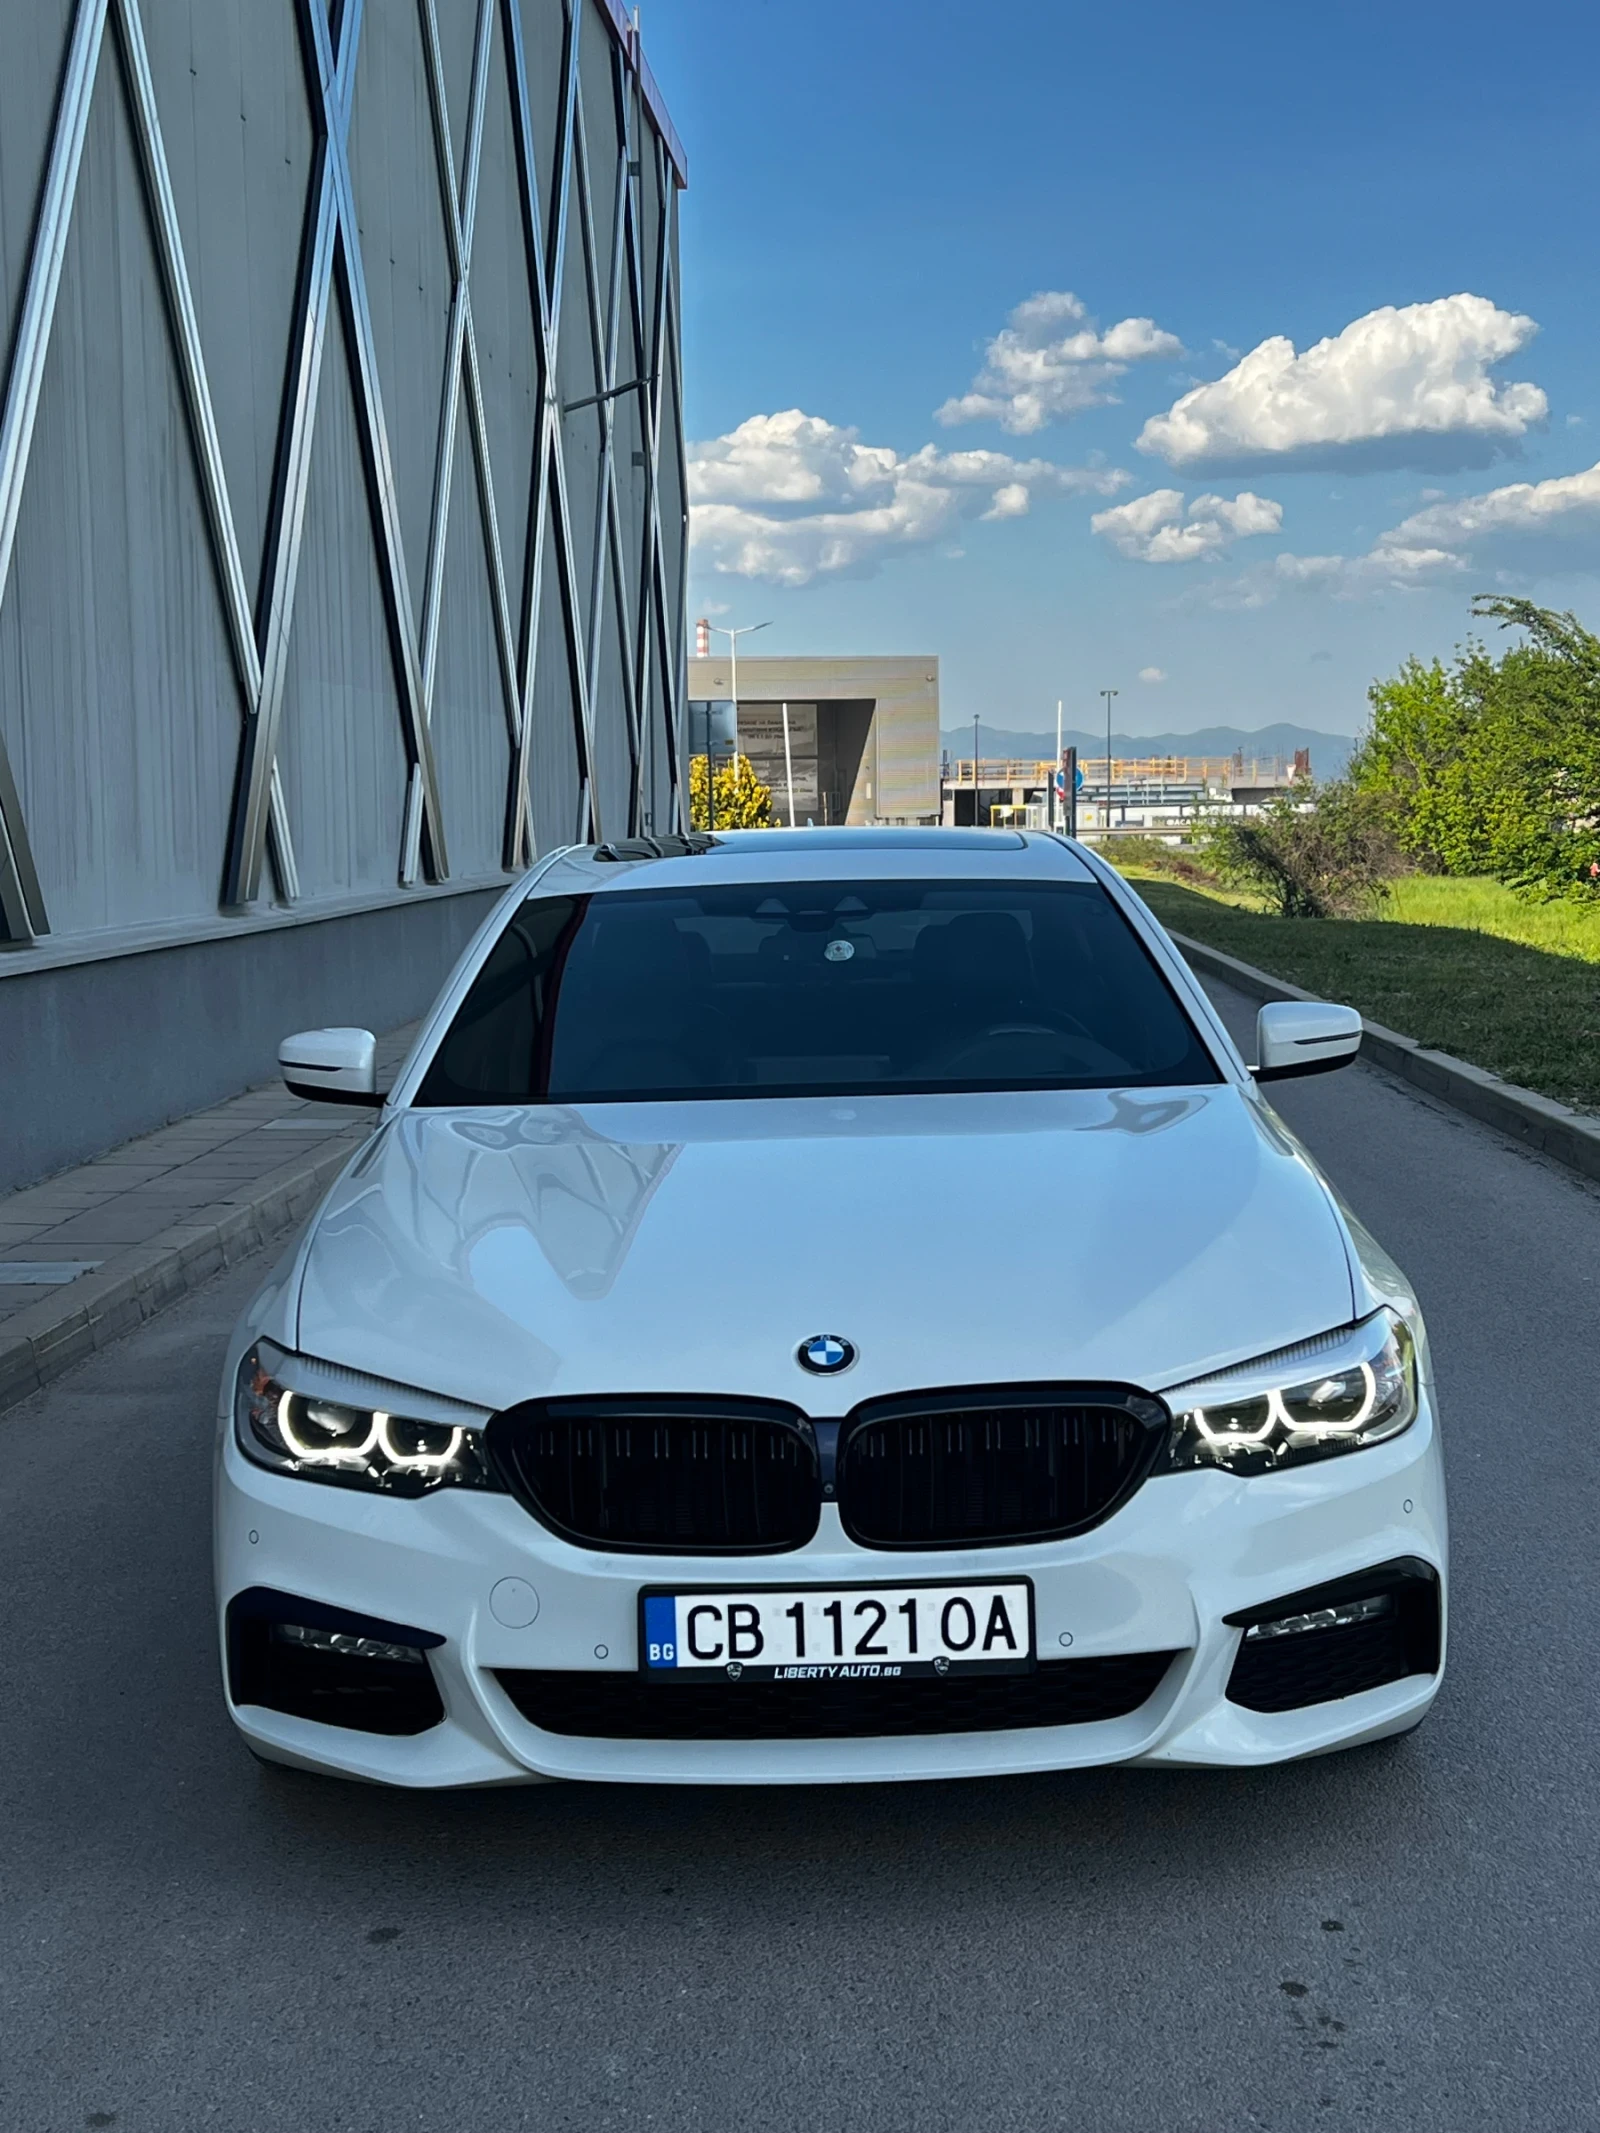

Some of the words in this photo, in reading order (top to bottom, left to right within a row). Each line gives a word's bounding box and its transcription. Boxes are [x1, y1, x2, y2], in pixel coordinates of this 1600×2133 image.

[687, 1603, 764, 1660] CB
[786, 1598, 918, 1658] 1121
[649, 1643, 675, 1661] BG
